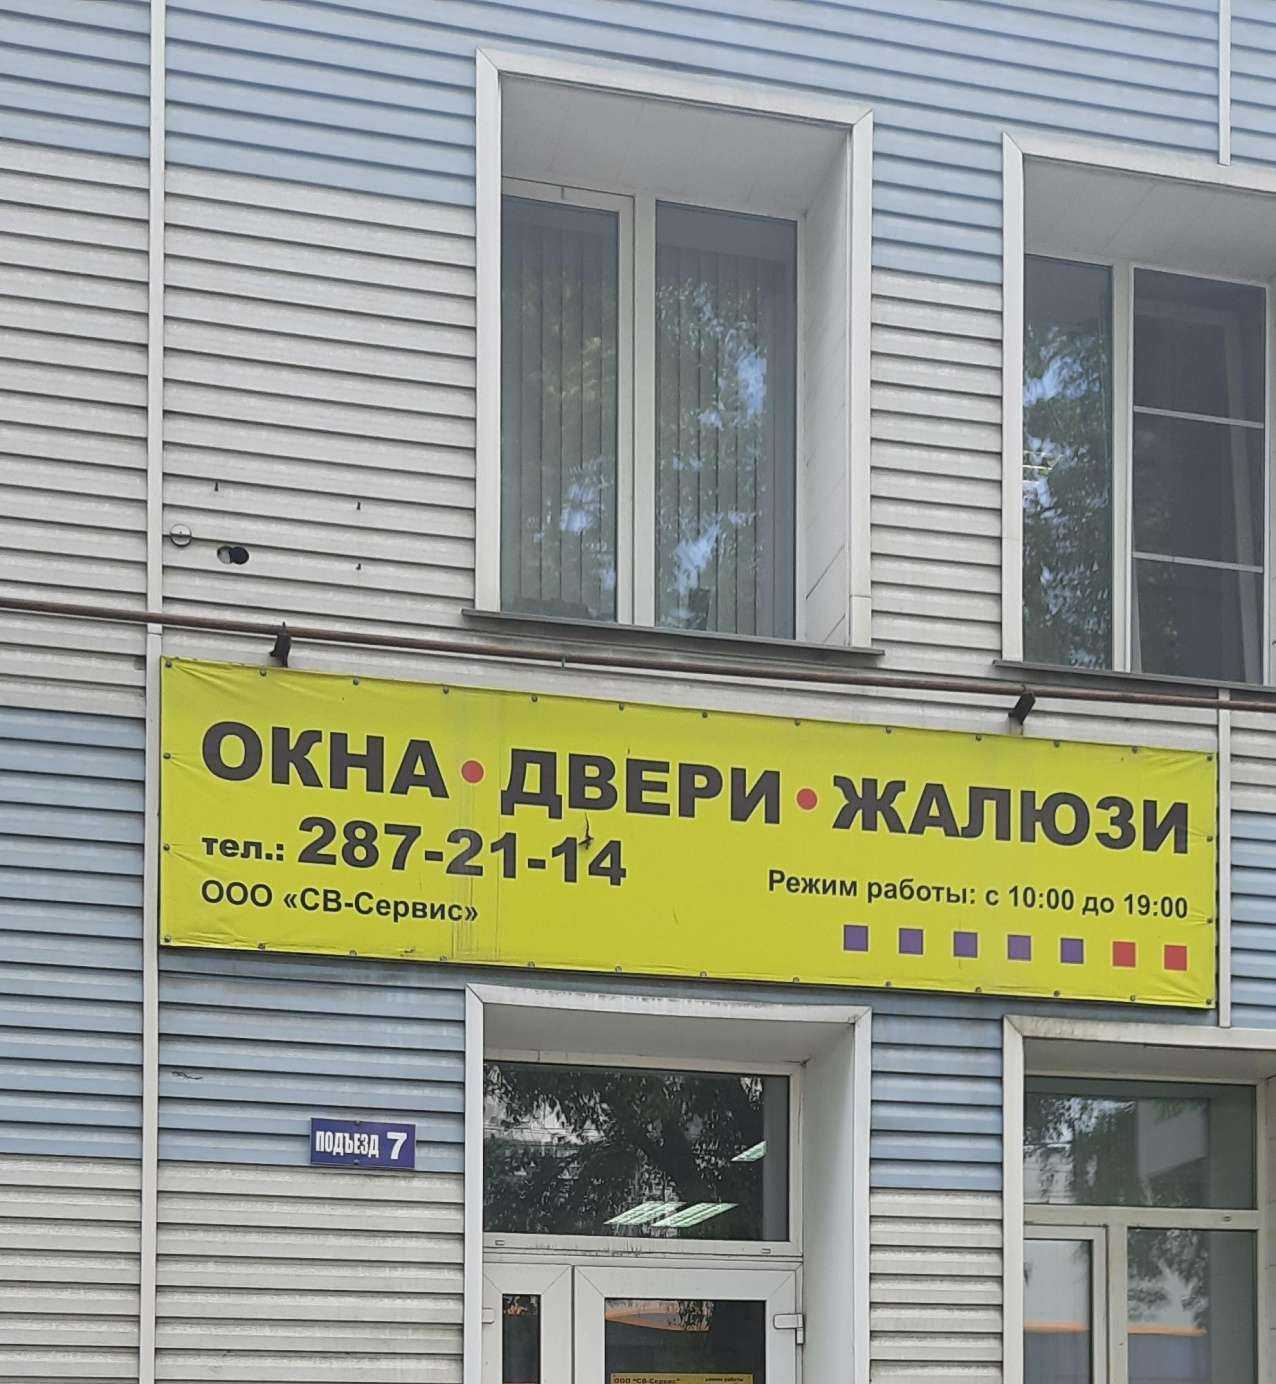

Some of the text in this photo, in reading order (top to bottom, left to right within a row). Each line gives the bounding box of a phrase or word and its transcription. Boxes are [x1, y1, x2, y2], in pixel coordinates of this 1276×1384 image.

[202, 721, 1189, 854] ОКНА ДВЕРИ ЖАЛЮЗИ
[202, 816, 628, 887] тел.: 287-21-14
[201, 879, 480, 923] ООО «СВ-Сервис»
[768, 869, 1188, 919] Режим работы: с 10:00 до 19:00
[315, 1130, 408, 1160] ПОДЪЕЗД 7
